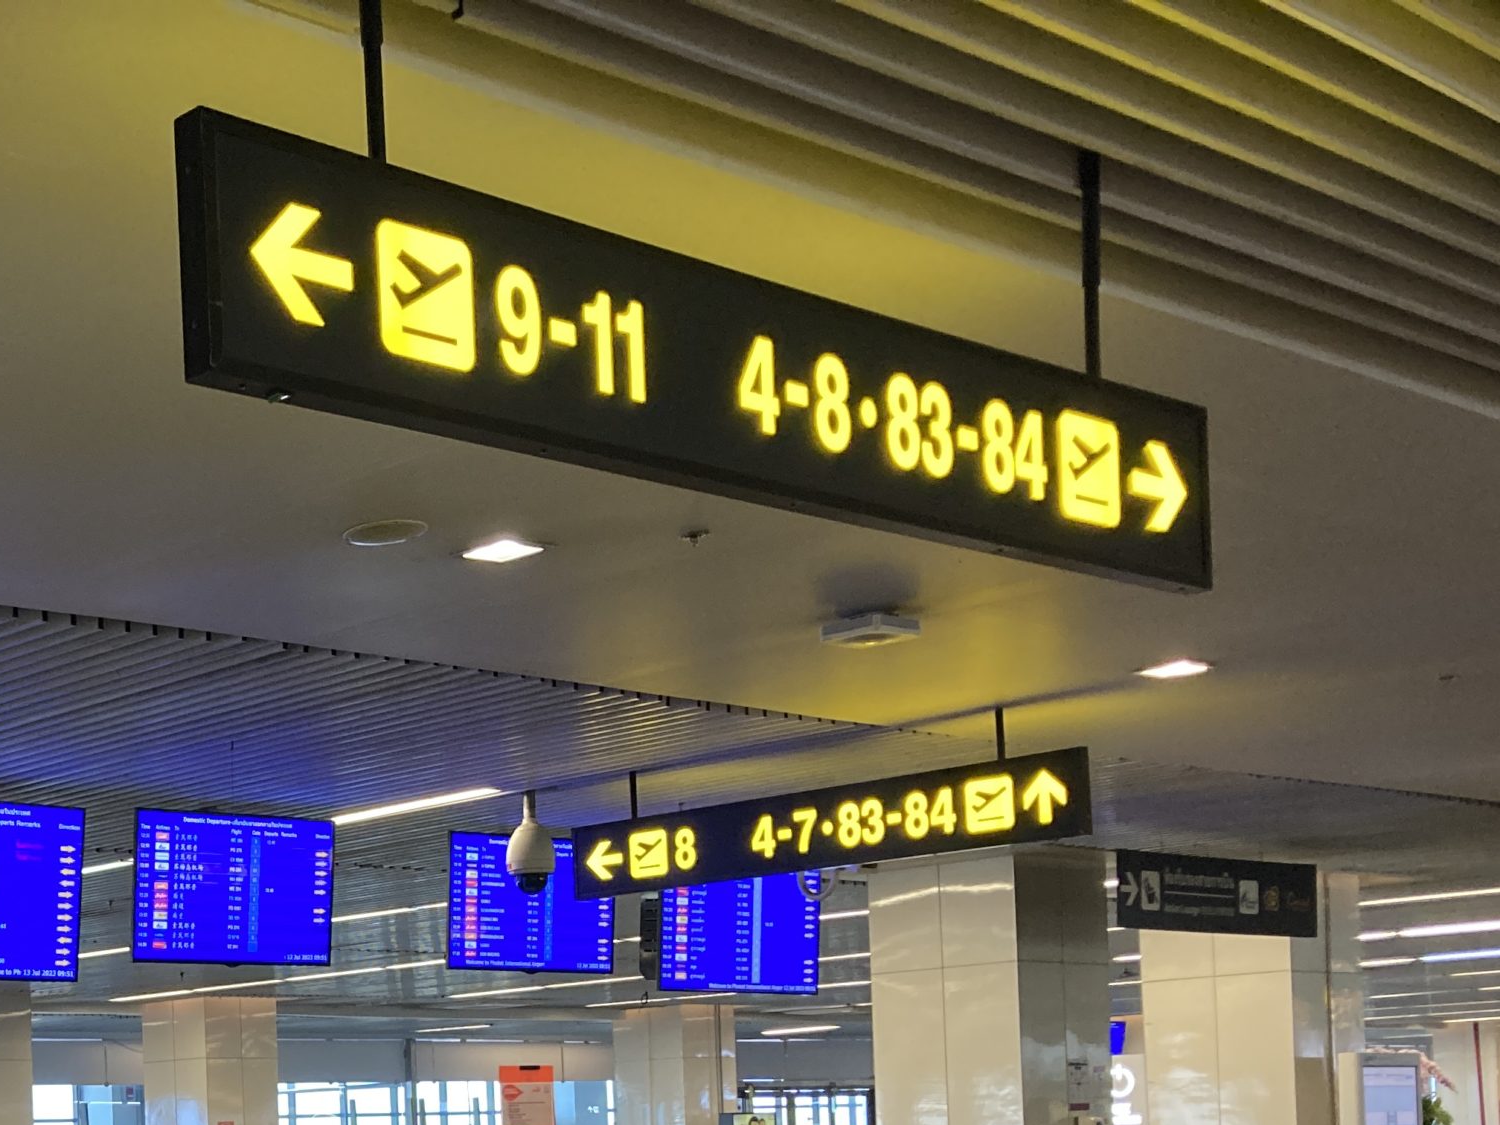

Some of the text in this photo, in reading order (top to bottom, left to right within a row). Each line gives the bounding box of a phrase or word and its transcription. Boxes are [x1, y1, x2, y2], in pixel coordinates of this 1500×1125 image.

[494, 265, 648, 403] 9-11
[16, 820, 41, 828] Remarks
[674, 827, 697, 870] 8
